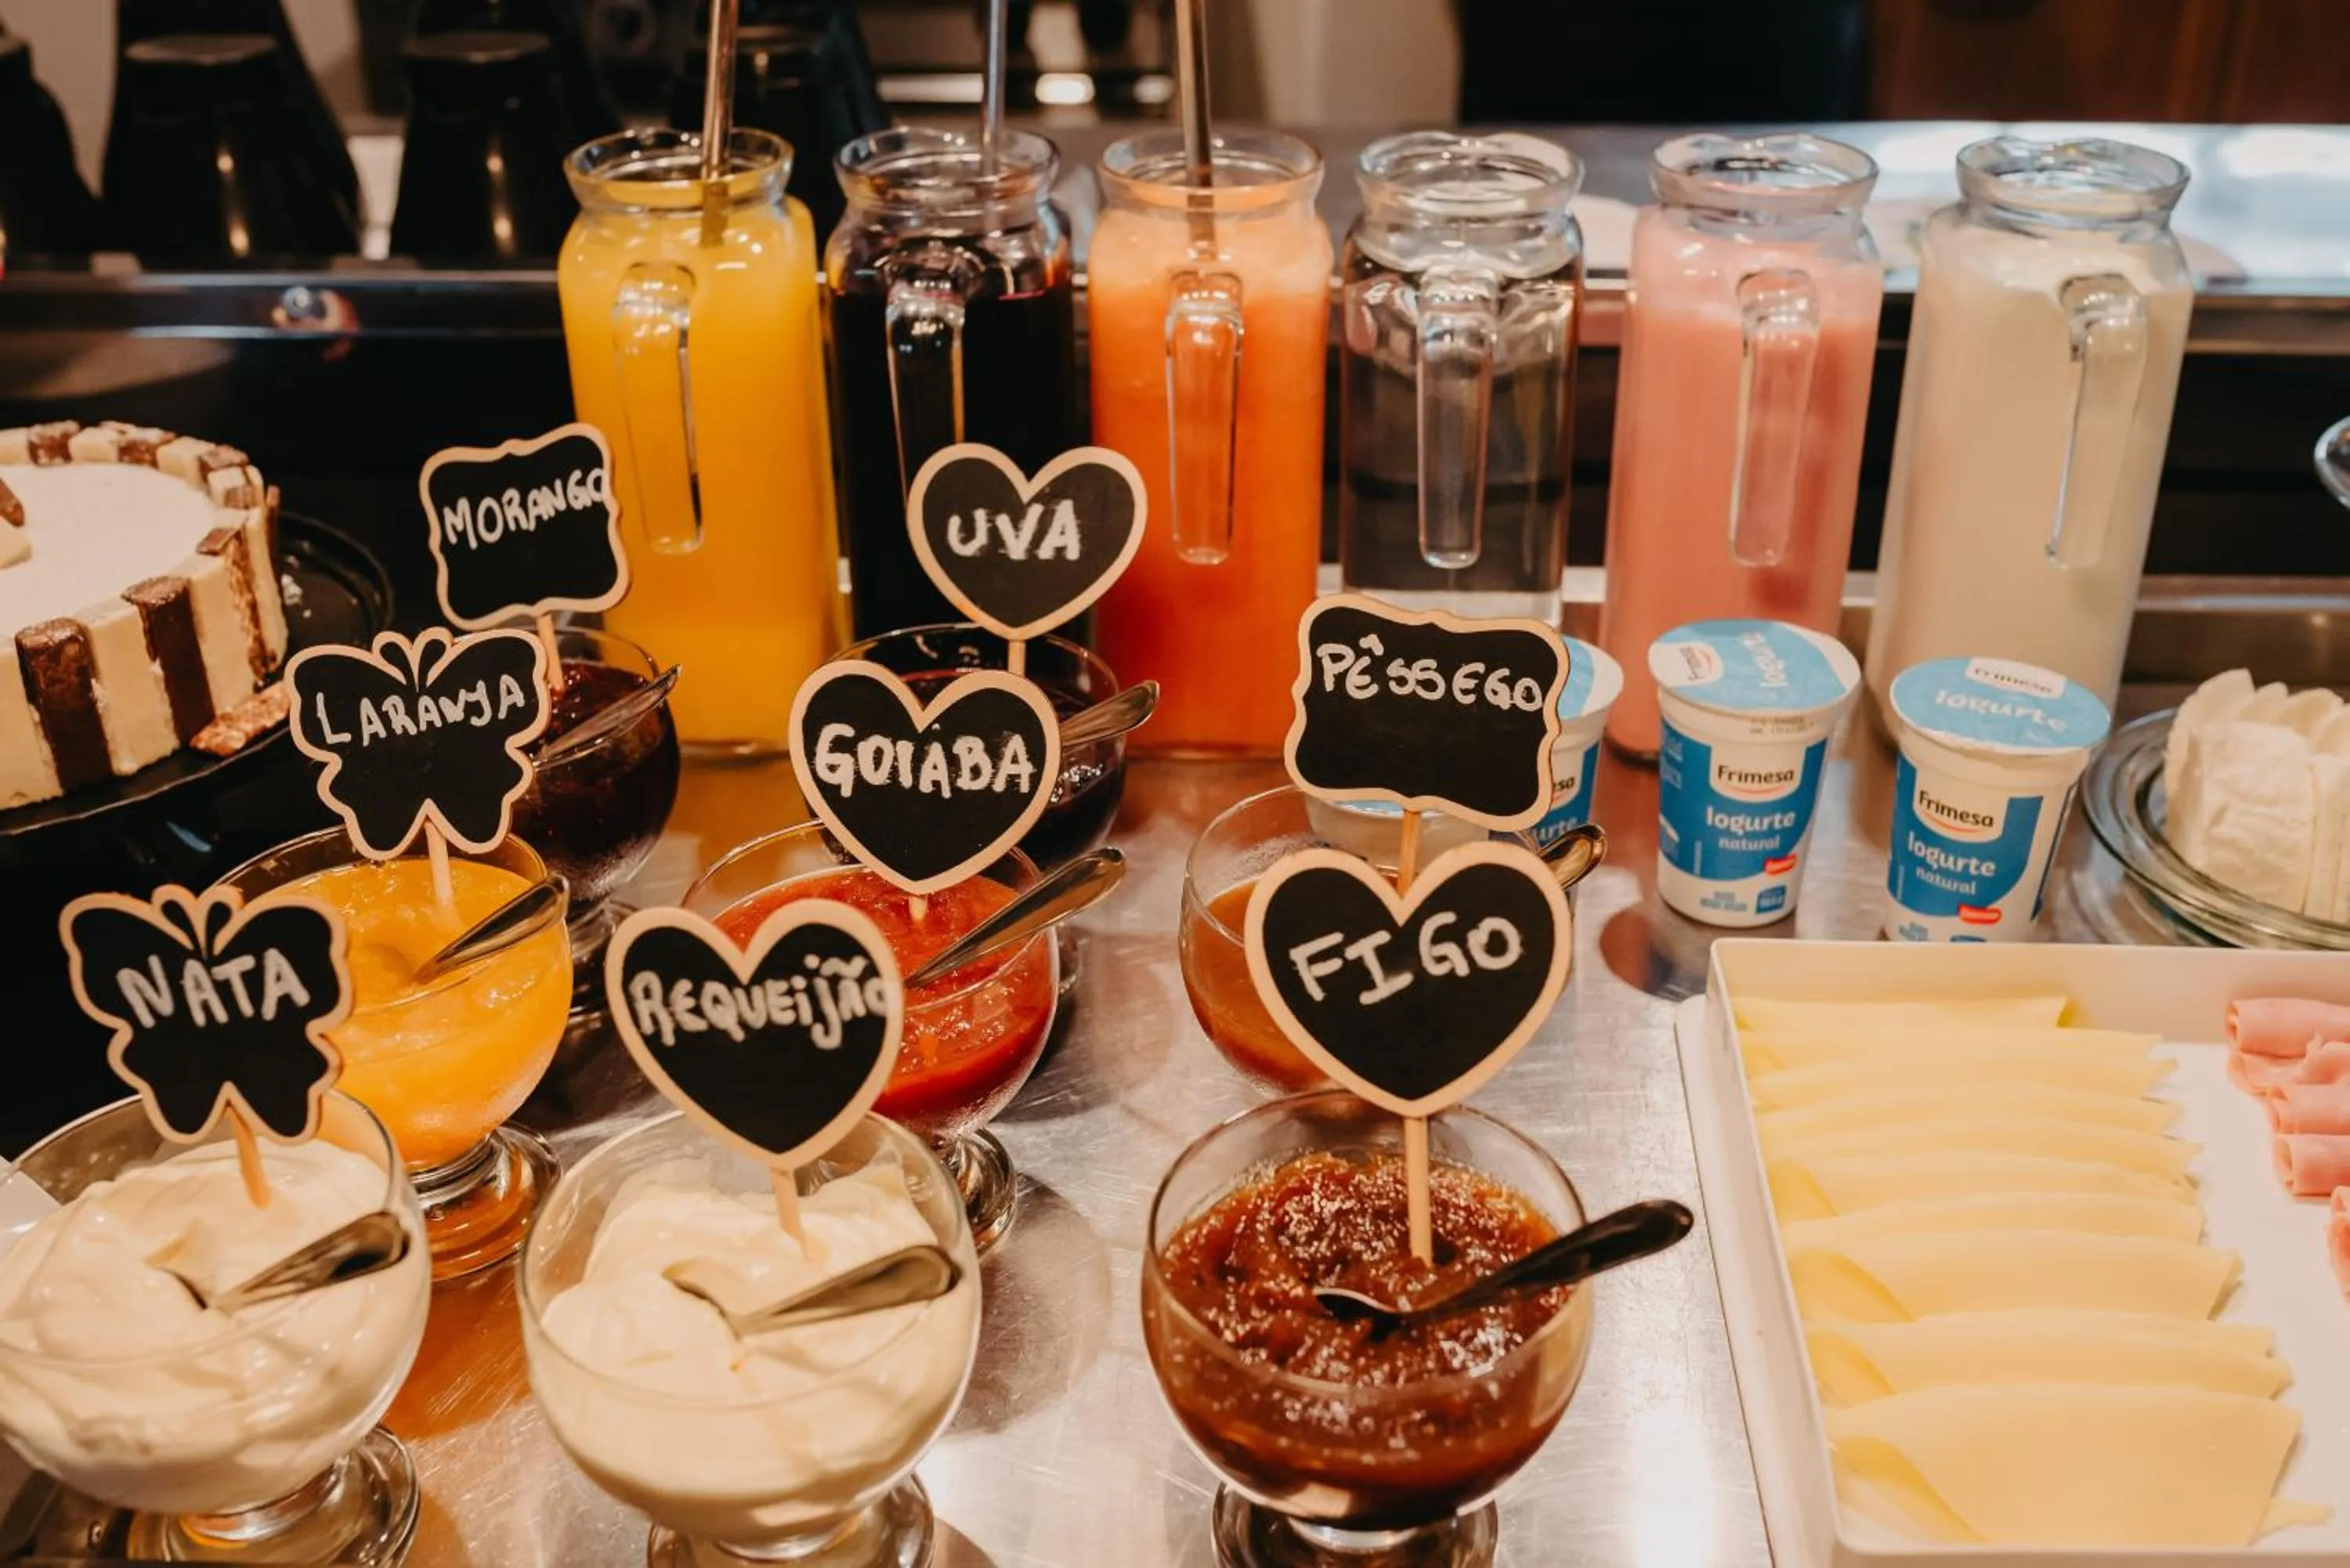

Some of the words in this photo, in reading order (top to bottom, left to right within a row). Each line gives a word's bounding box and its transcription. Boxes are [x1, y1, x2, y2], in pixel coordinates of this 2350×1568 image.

[443, 468, 609, 550] MORANGO
[947, 499, 1080, 561] UVA
[1315, 634, 1544, 712] PÊSSEGO
[316, 674, 526, 746] LARANJA
[1935, 688, 2068, 732] Iogurte
[815, 723, 1037, 799] GOIABA
[1717, 764, 1795, 784] Frimesa
[1706, 805, 1797, 836] Iogurte
[1919, 789, 1994, 828] Frimesa
[1719, 834, 1781, 851] natural
[1907, 830, 1997, 877] Iogurte
[1916, 866, 1977, 896] natural
[1289, 911, 1522, 1006] FIGO
[115, 948, 311, 1028] NATA
